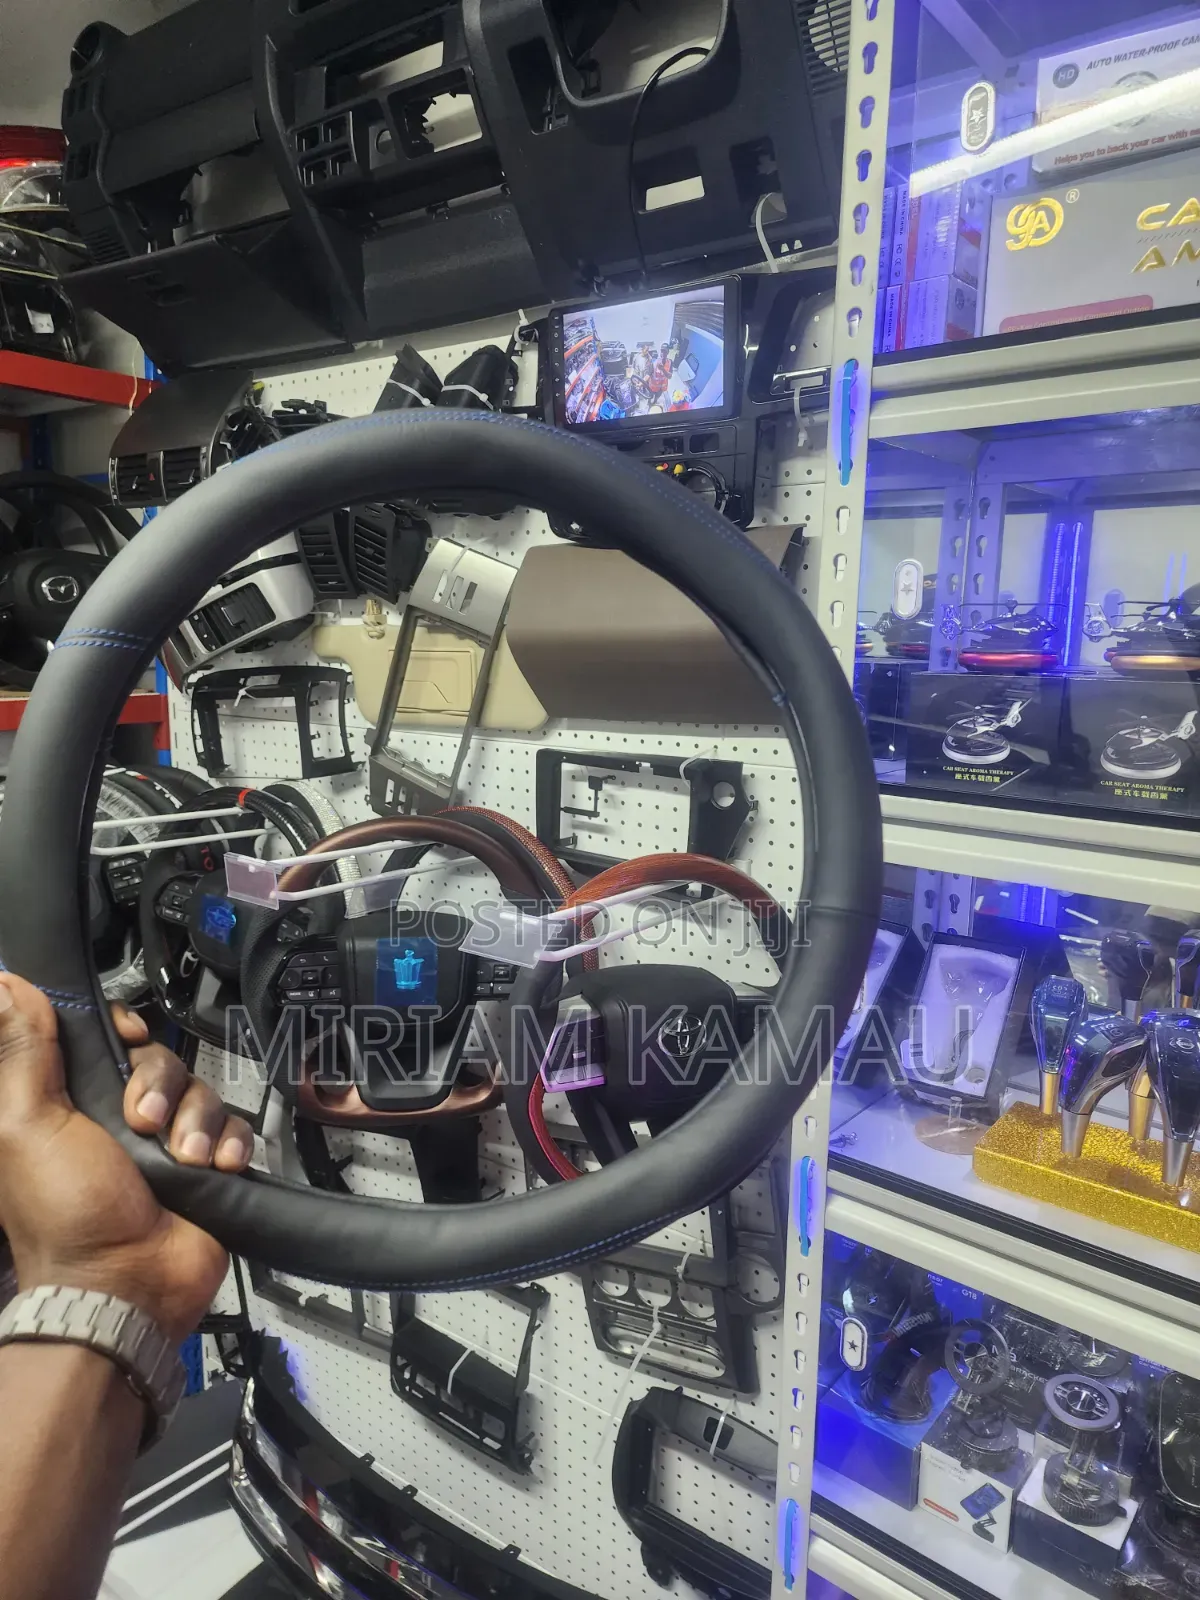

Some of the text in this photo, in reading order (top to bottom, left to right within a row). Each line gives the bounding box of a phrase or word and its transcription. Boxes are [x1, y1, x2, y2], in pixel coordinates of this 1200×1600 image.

[1086, 57, 1112, 70] AUTO
[1113, 39, 1180, 64] WATER-PROOF
[1058, 69, 1075, 81] HD
[1054, 154, 1078, 165] Helps
[1080, 150, 1095, 161] you
[1096, 148, 1105, 156] to
[1107, 143, 1129, 154] back
[1130, 139, 1150, 150] your
[1151, 135, 1167, 144] car
[1168, 129, 1188, 140] with
[1154, 785, 1185, 793] THERAPY
